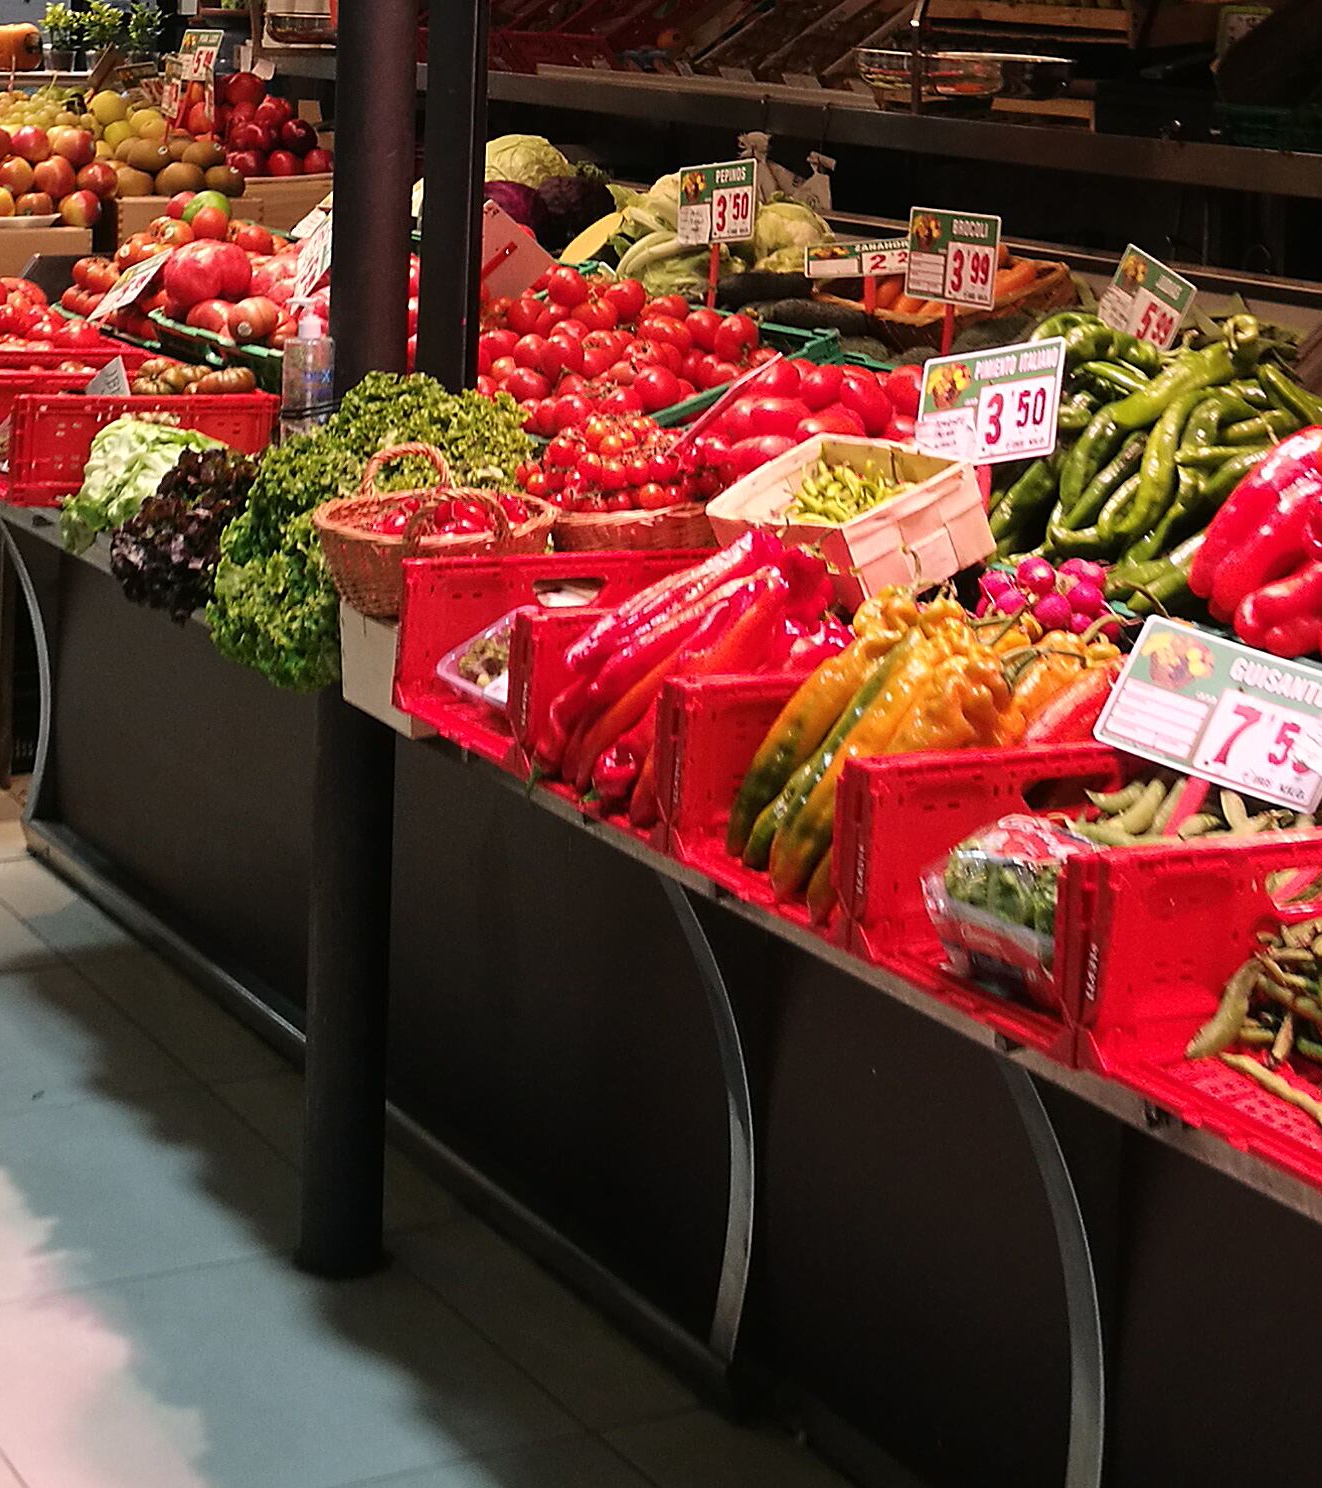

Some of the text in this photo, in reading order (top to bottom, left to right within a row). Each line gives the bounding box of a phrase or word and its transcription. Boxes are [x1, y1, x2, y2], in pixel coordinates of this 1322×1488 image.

[715, 166, 747, 184] PEPINOS
[716, 192, 749, 232] 3'50
[950, 248, 991, 293] 3'99
[984, 387, 1047, 445] 3'50
